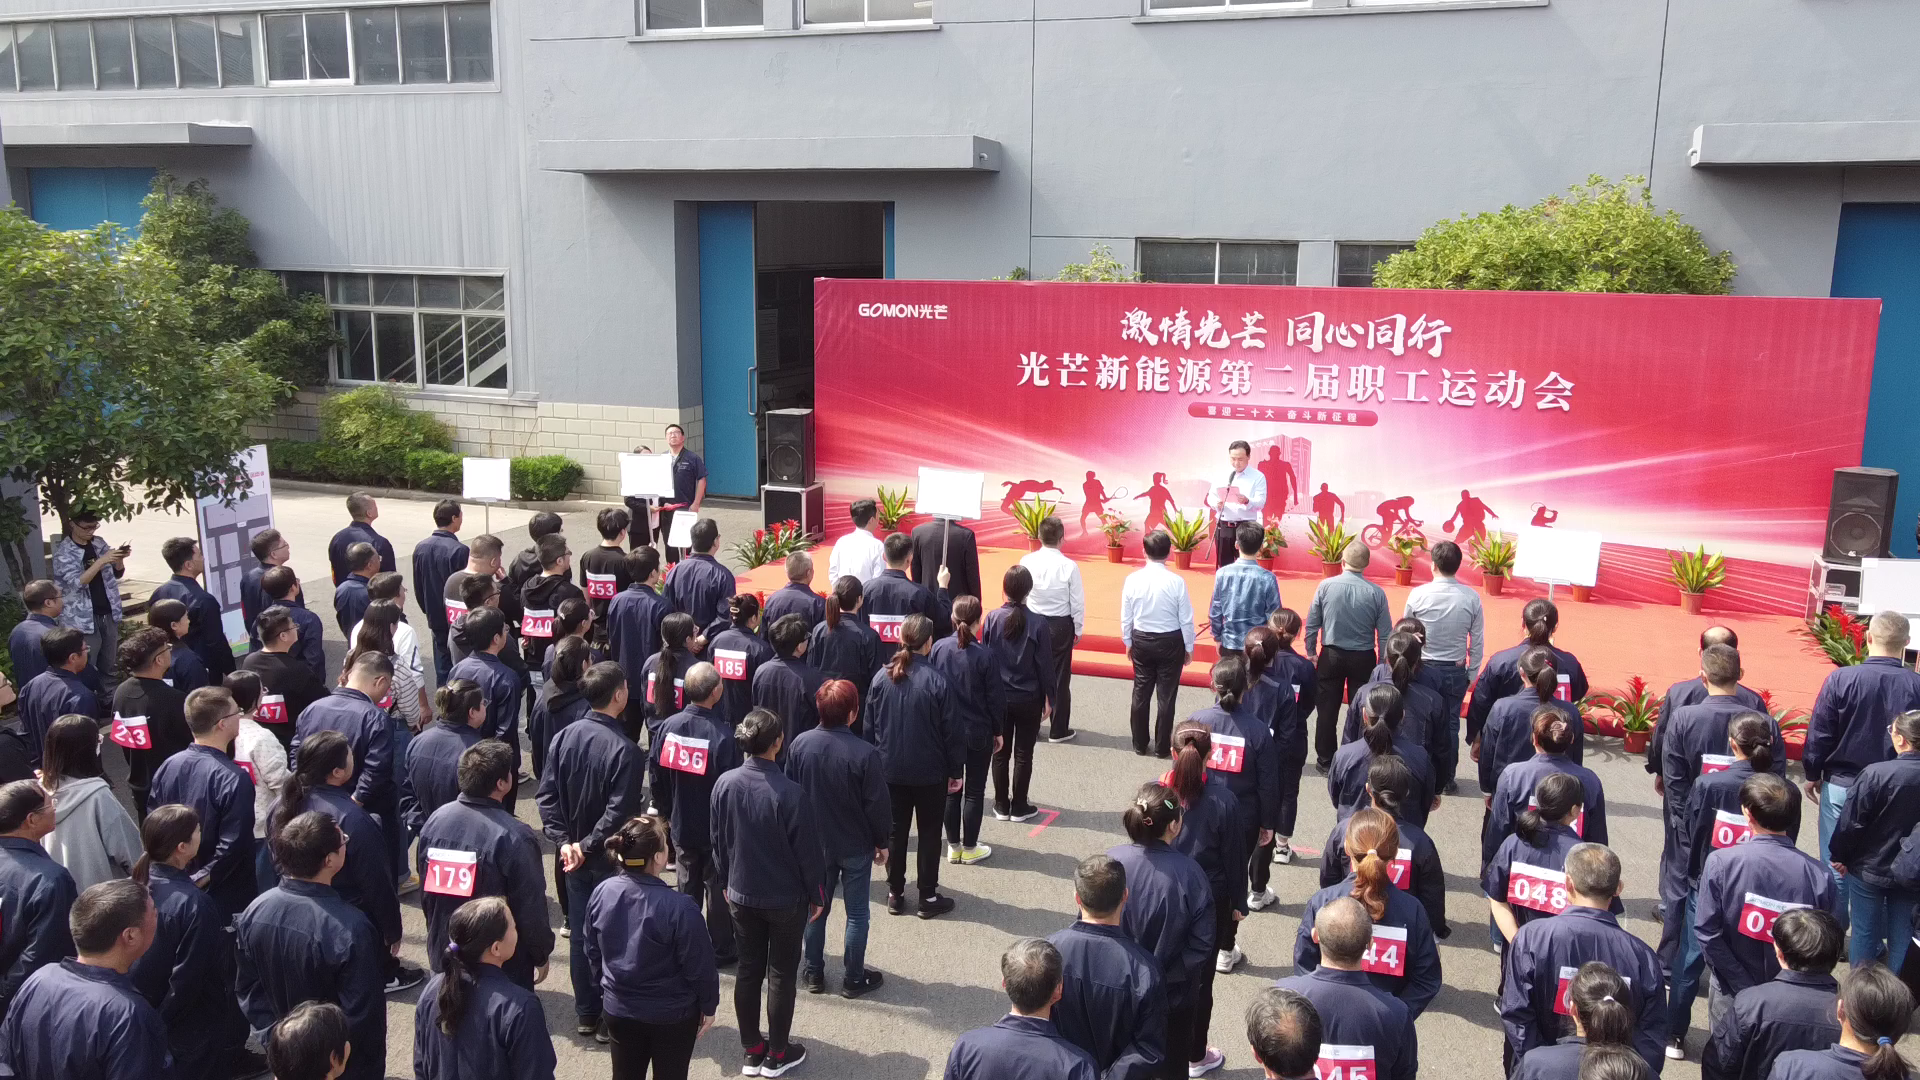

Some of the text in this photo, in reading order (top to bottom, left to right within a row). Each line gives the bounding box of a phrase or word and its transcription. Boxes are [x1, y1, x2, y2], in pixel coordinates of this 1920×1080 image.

[1120, 307, 1452, 358] 激情光芒 同心同行
[1016, 352, 1576, 412] 光芒新能源第二届职工运动会
[1207, 405, 1358, 423] 喜迎二十大 奋斗新征程
[589, 582, 614, 596] 253
[524, 617, 553, 633] 240
[717, 659, 744, 677] 185
[667, 745, 703, 769] 196
[432, 864, 472, 890] 179
[1514, 878, 1567, 909] 048
